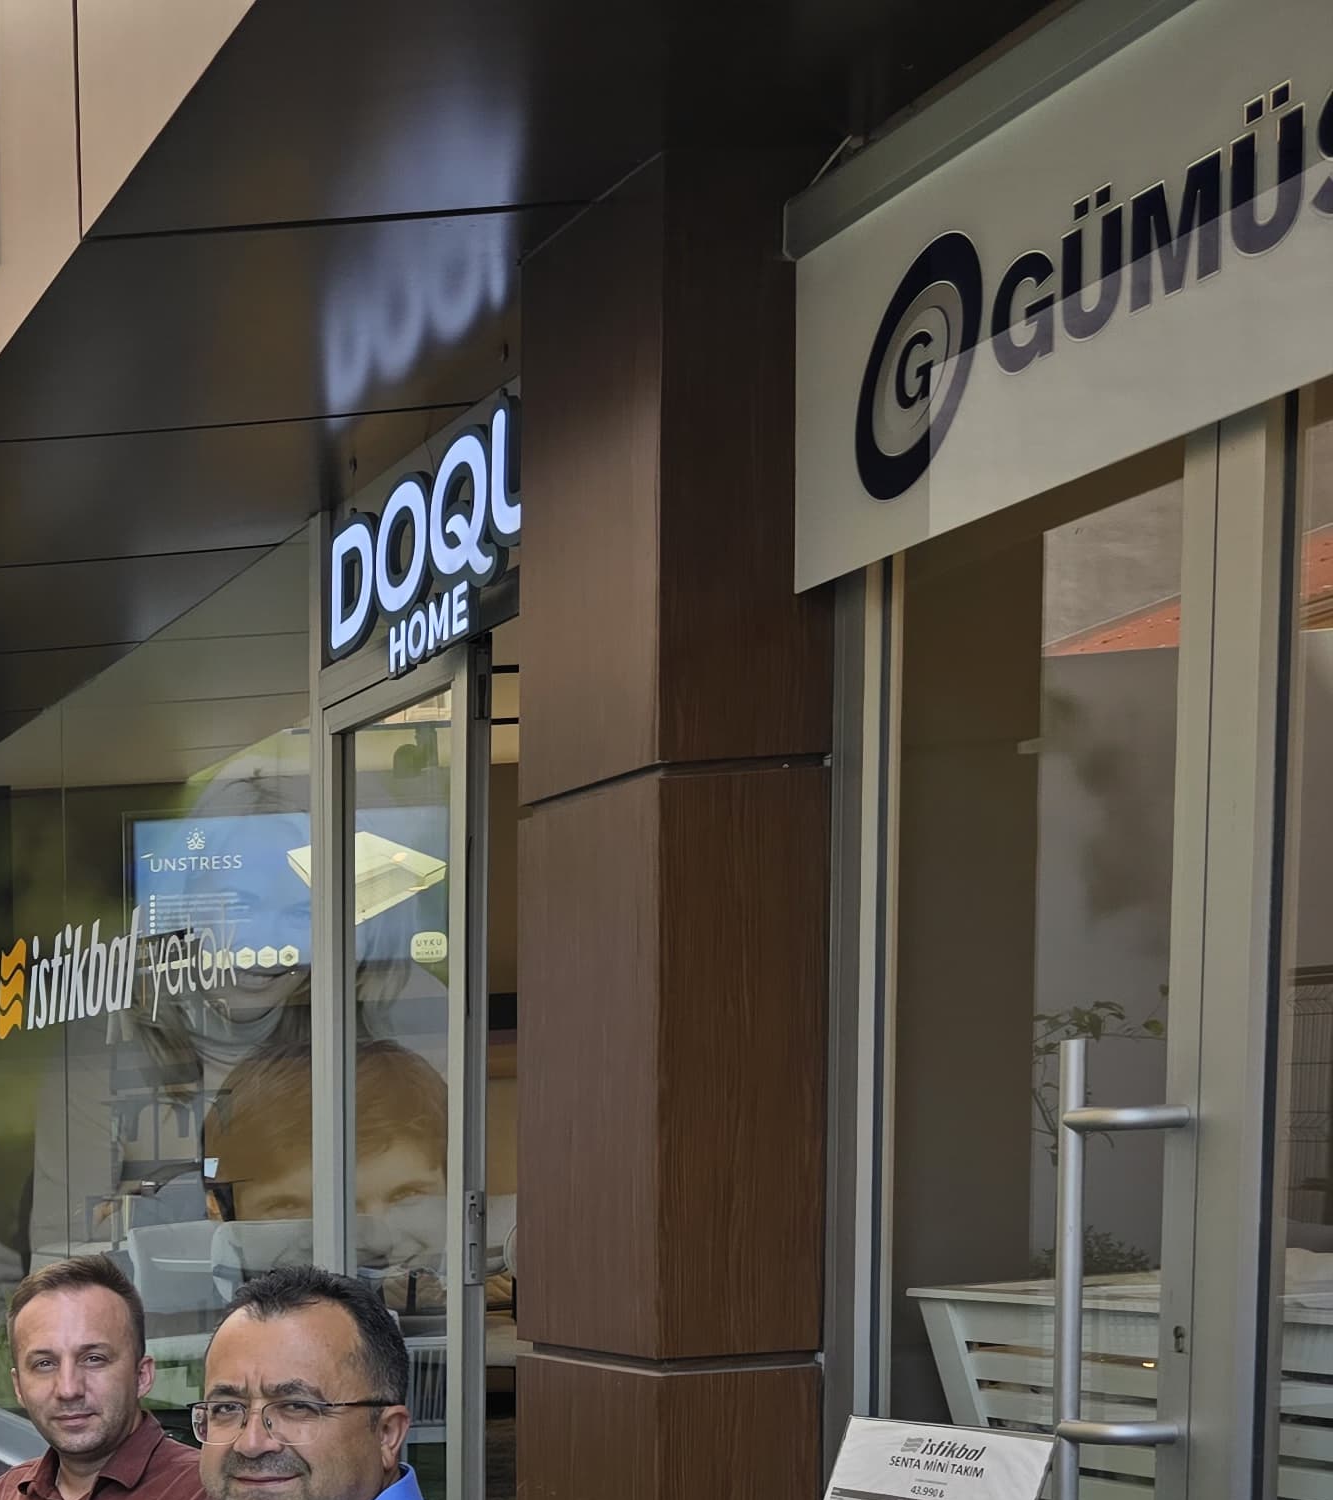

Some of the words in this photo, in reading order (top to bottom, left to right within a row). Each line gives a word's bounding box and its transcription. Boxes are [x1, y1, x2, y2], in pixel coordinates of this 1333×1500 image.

[991, 80, 1333, 375] GÜMÜ
[389, 580, 469, 673] HOME
[150, 855, 243, 873] UNSTRESS
[27, 904, 141, 1031] istikbal
[149, 899, 238, 1023] yatak
[921, 1438, 987, 1461] istikbal
[889, 1455, 922, 1470] SENTA
[923, 1459, 949, 1474] MİNİ
[950, 1463, 985, 1478] TAKIM
[910, 1485, 938, 1498] 43.990
